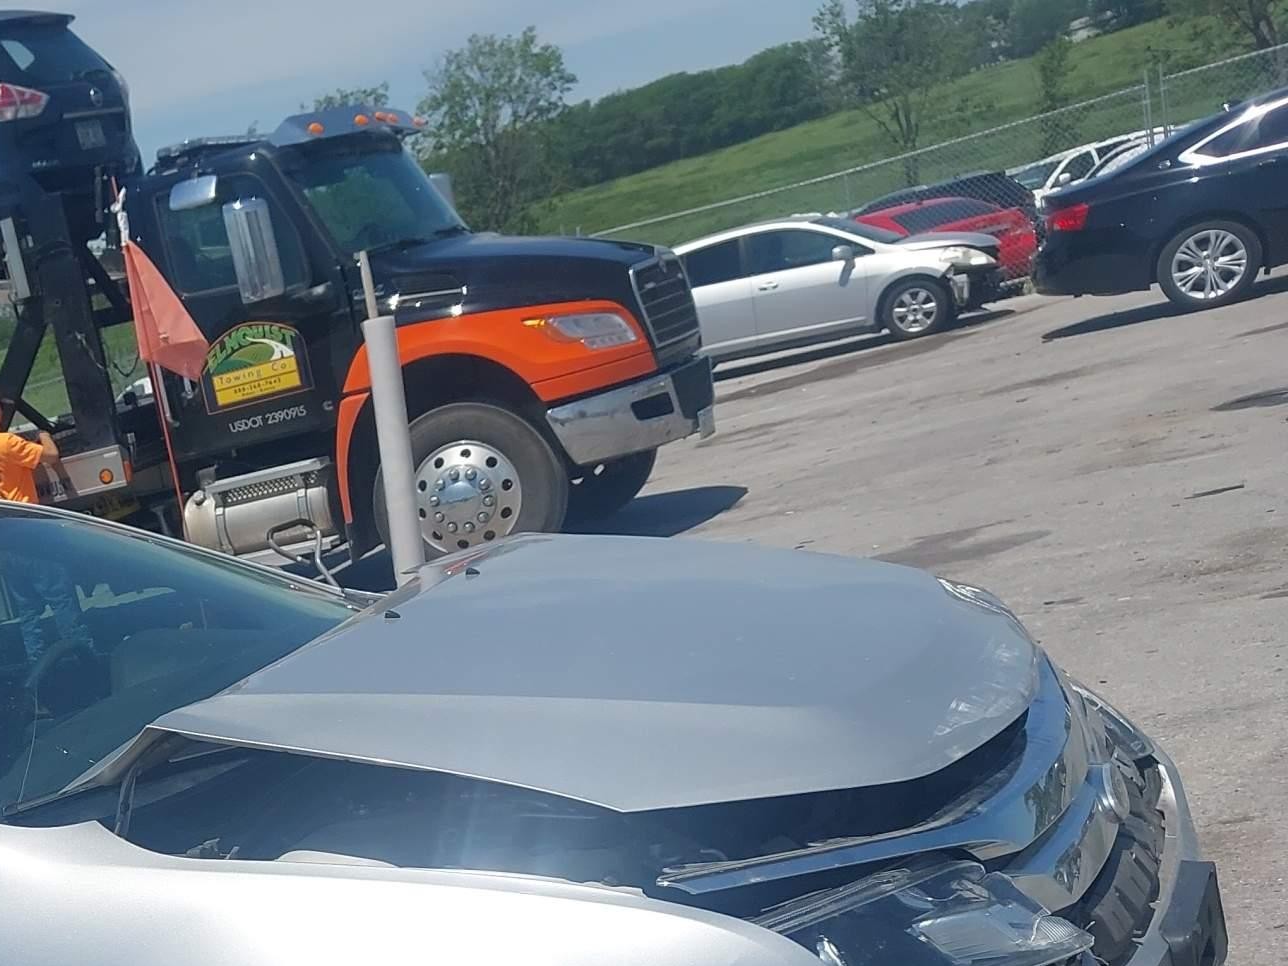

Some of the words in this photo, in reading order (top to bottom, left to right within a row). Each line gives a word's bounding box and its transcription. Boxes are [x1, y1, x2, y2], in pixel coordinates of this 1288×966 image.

[207, 325, 296, 371] ELMQUIST
[218, 368, 263, 385] Towing
[228, 415, 264, 433] USDOT
[265, 404, 307, 424] 2390915
